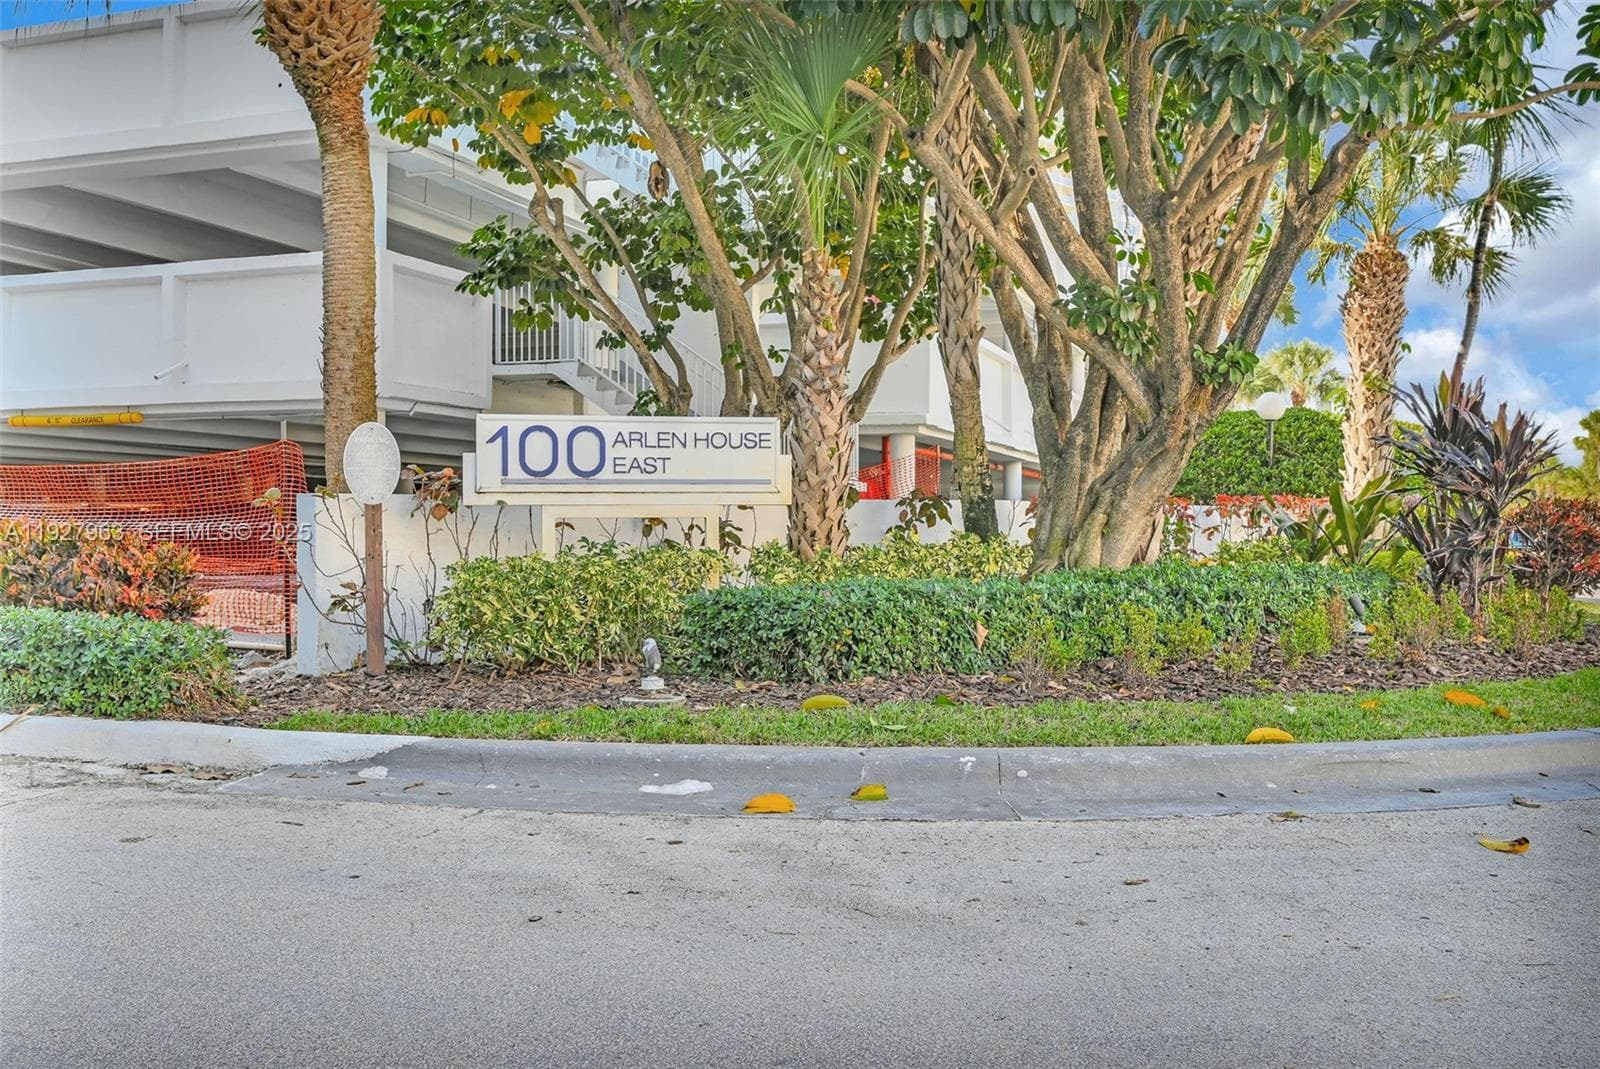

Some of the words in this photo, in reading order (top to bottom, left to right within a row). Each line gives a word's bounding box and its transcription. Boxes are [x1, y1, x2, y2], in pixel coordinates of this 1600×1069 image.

[70, 416, 105, 424] CLEARANCE
[612, 431, 687, 449] ARLEN
[694, 431, 772, 449] HOUSE
[486, 425, 606, 478] 100
[612, 457, 671, 474] EAST
